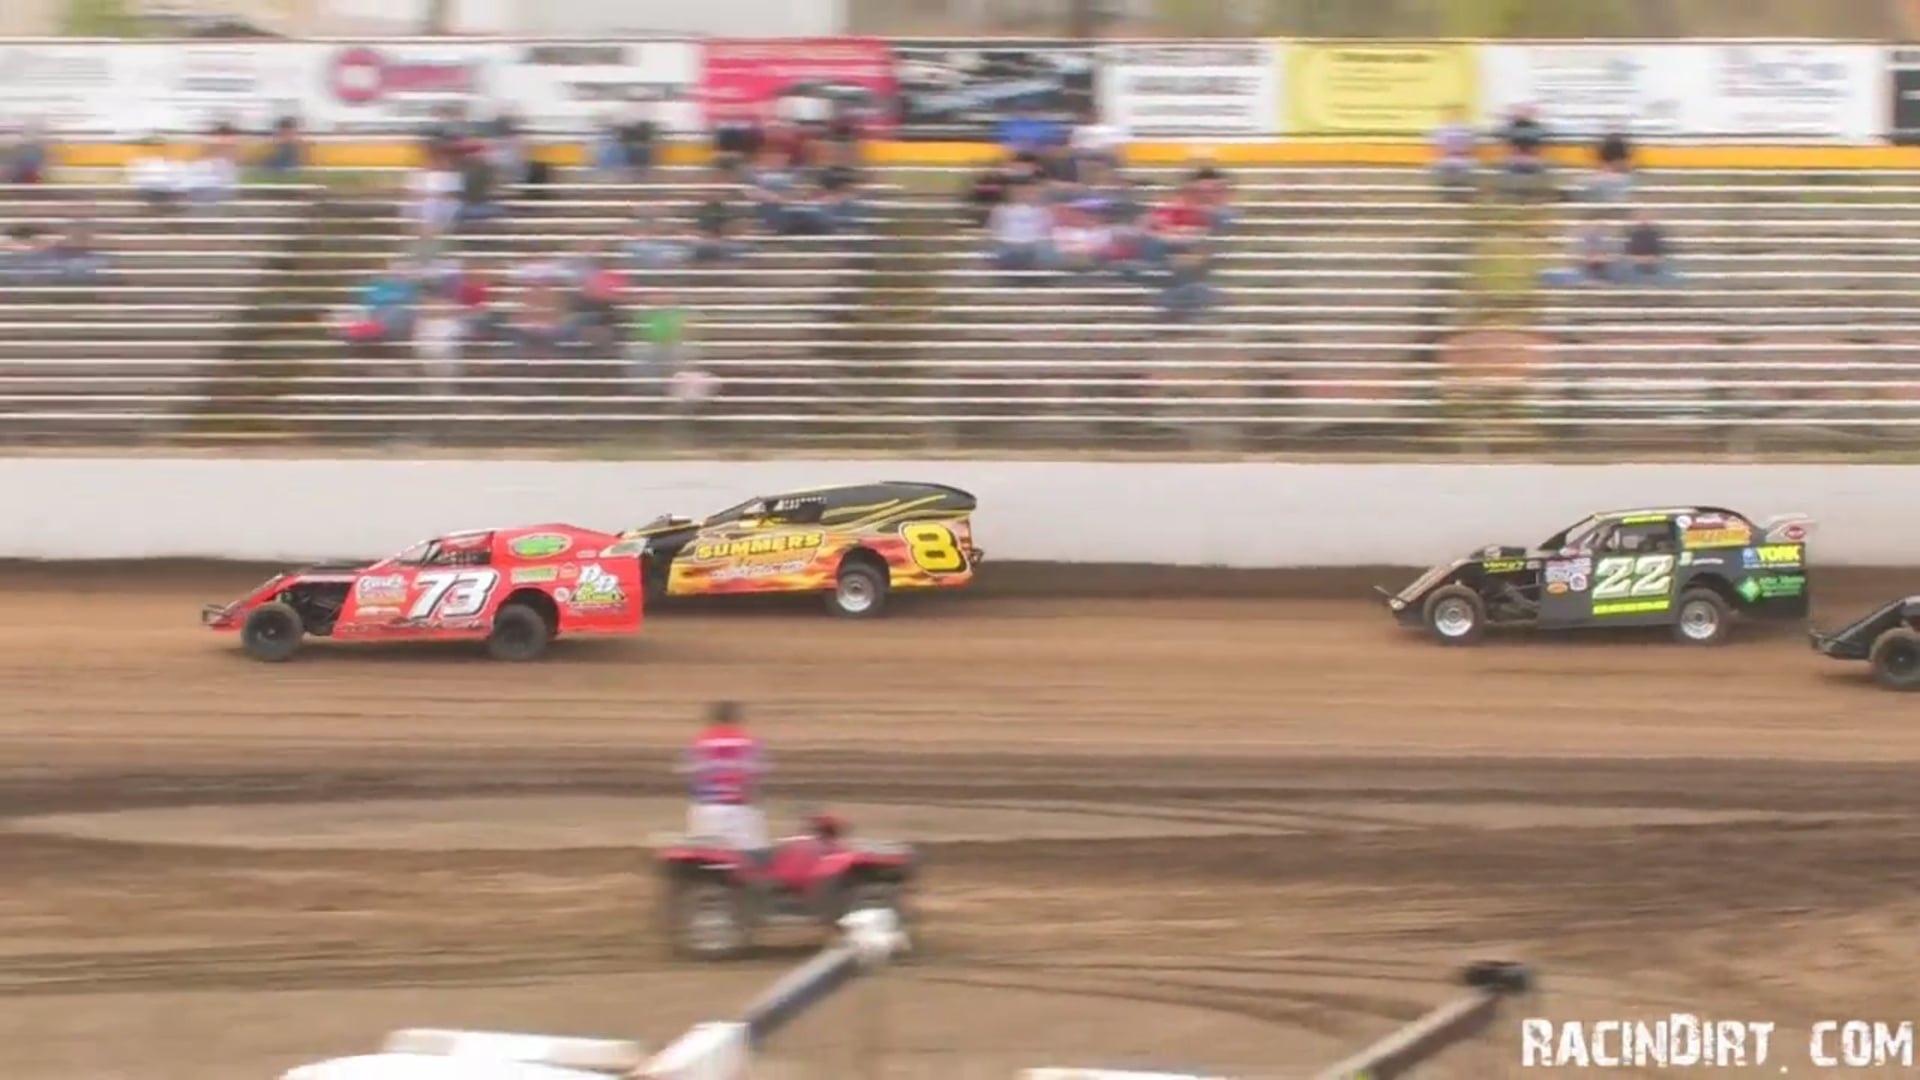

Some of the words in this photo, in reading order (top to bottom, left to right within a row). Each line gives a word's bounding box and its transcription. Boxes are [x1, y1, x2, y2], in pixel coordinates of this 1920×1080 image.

[697, 531, 823, 560] SUMMERS
[900, 521, 968, 575] 8
[1756, 545, 1802, 562] YORK
[409, 568, 498, 620] 73
[1592, 554, 1675, 599] 22
